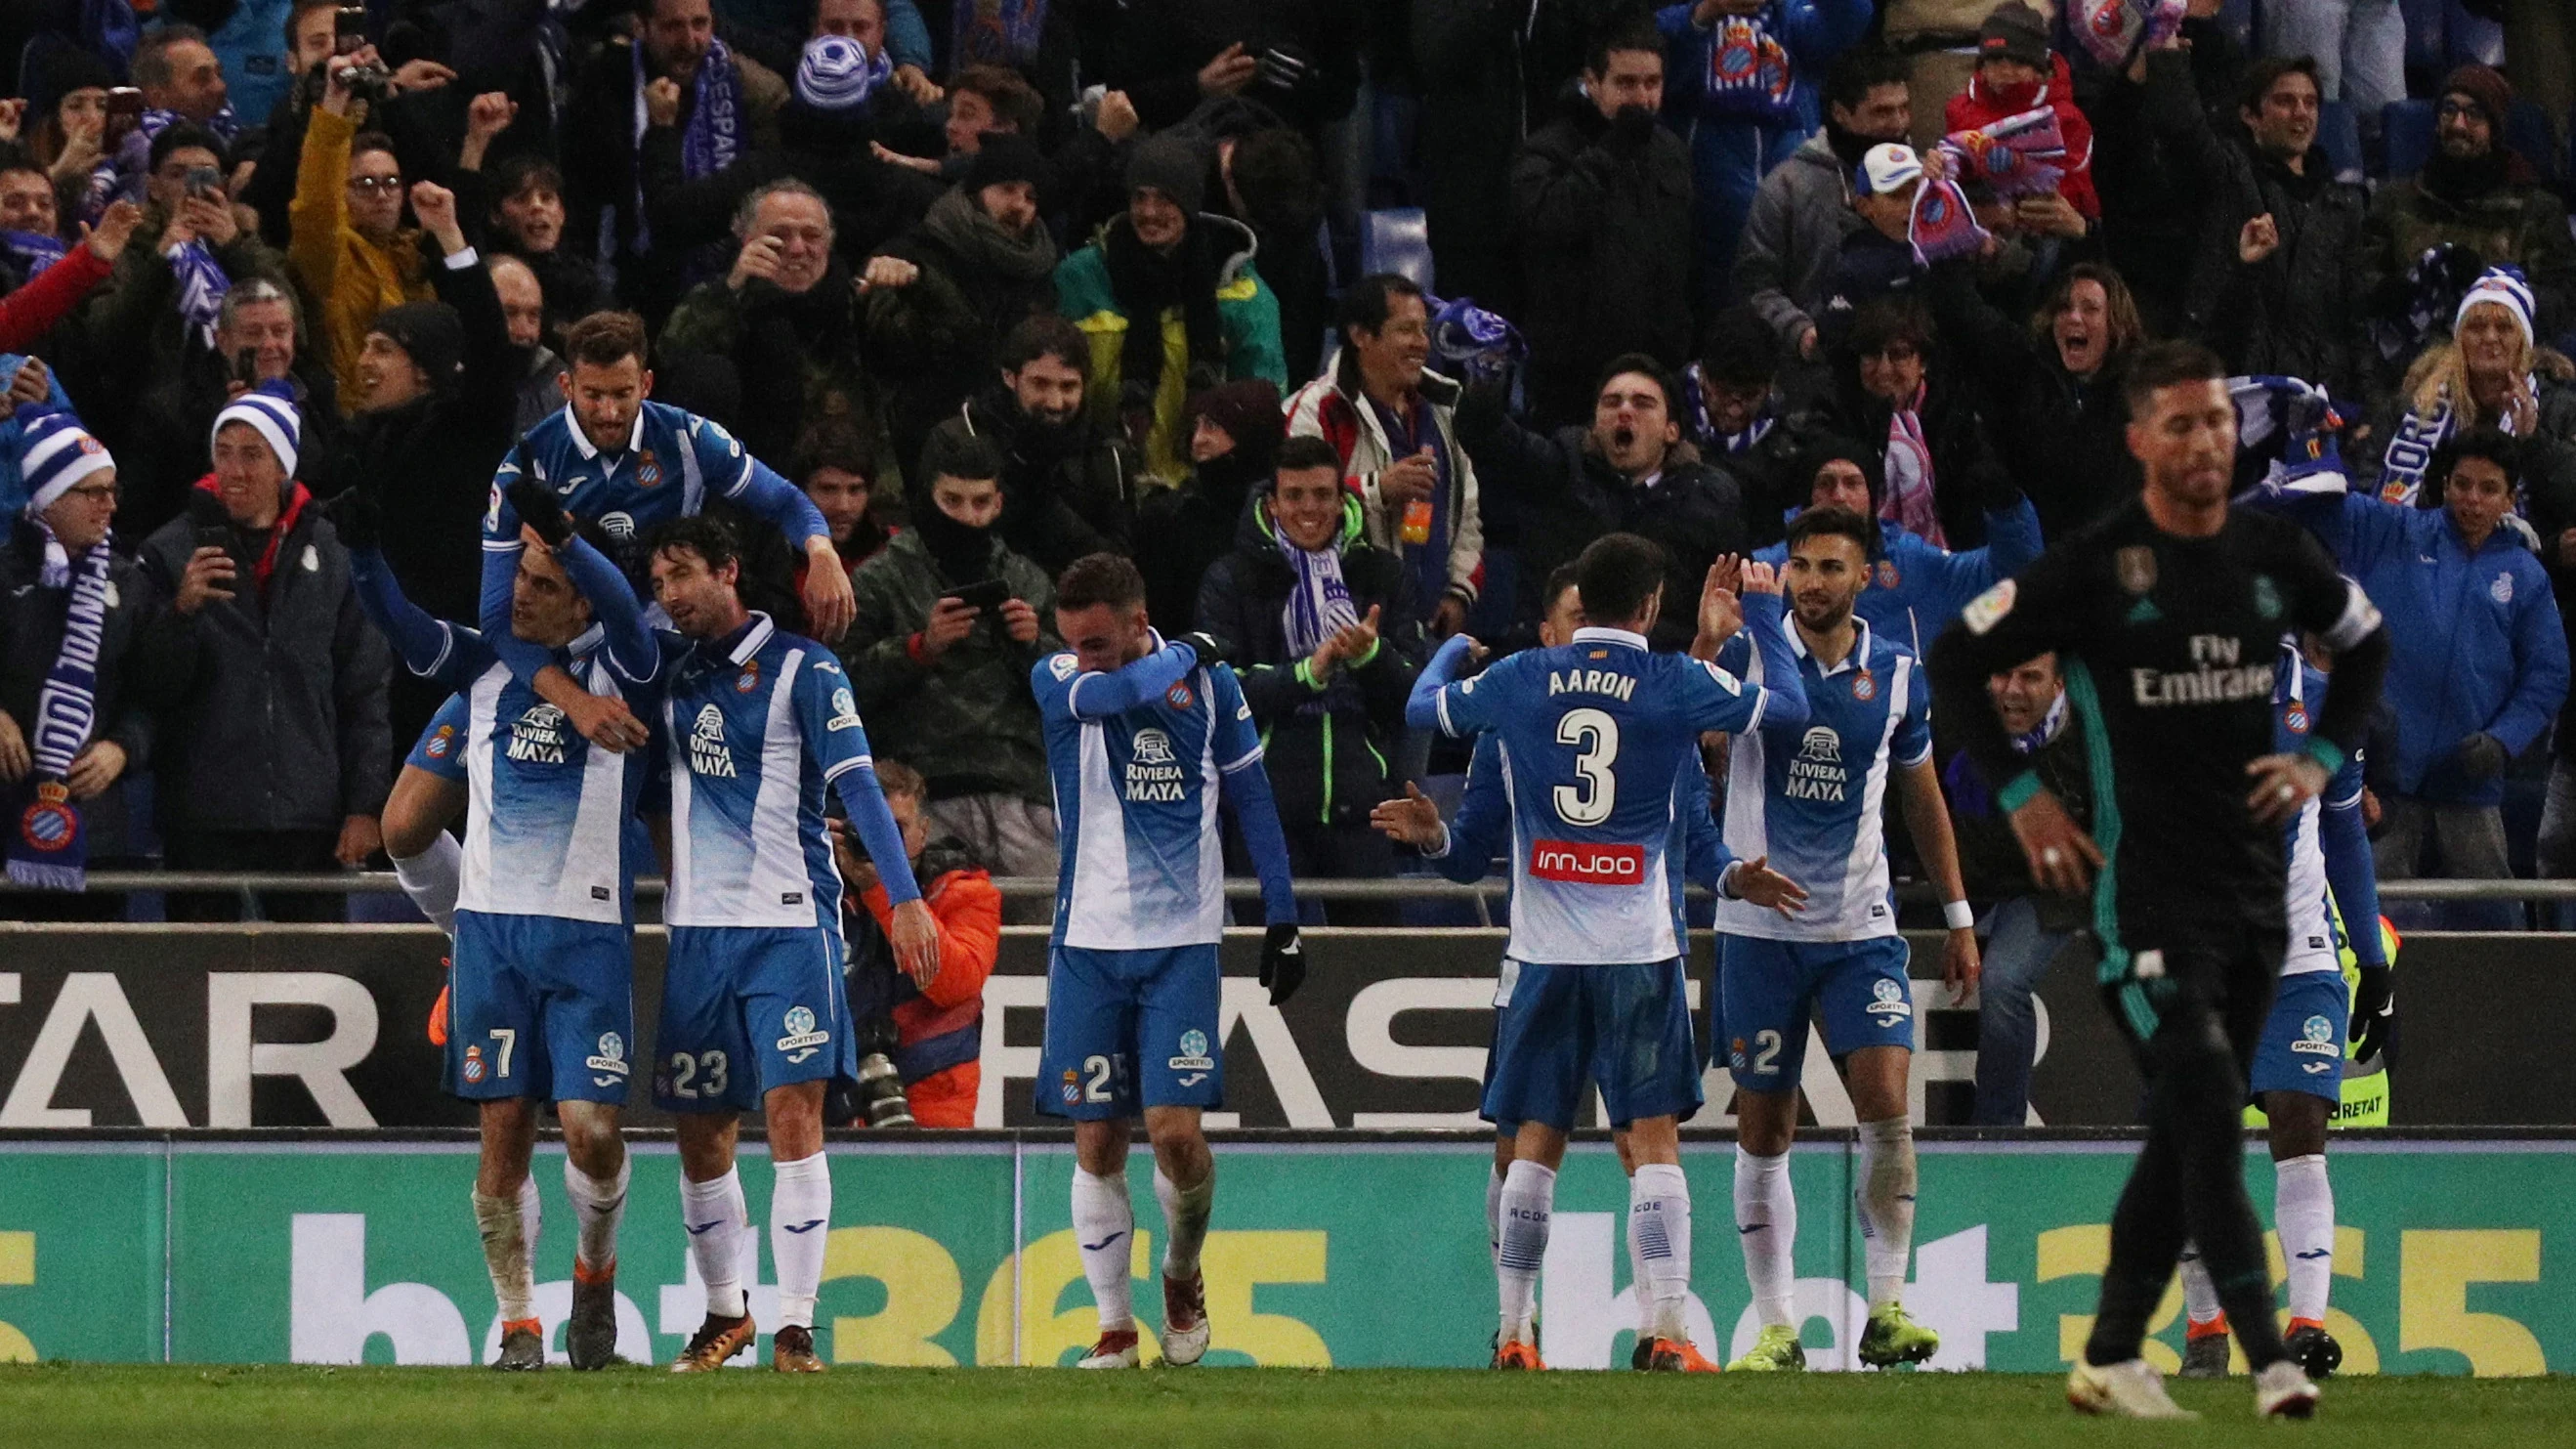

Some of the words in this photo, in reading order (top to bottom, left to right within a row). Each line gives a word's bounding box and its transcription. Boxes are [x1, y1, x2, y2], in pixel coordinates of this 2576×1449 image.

[2189, 635, 2240, 664] Fly
[1548, 669, 1636, 702] AARON
[506, 737, 565, 763] MAYA
[691, 752, 737, 778] MAYA
[1126, 764, 1184, 781] RIVIERA
[1552, 707, 1619, 827] 3
[1788, 759, 1847, 782] RIVIERA
[1125, 783, 1185, 801] MAYA
[1785, 776, 1845, 801] MAYA
[781, 1033, 826, 1046] SPORTYCO
[1754, 1029, 1782, 1074] 2
[489, 1029, 515, 1077] 7
[672, 1050, 728, 1099] 23
